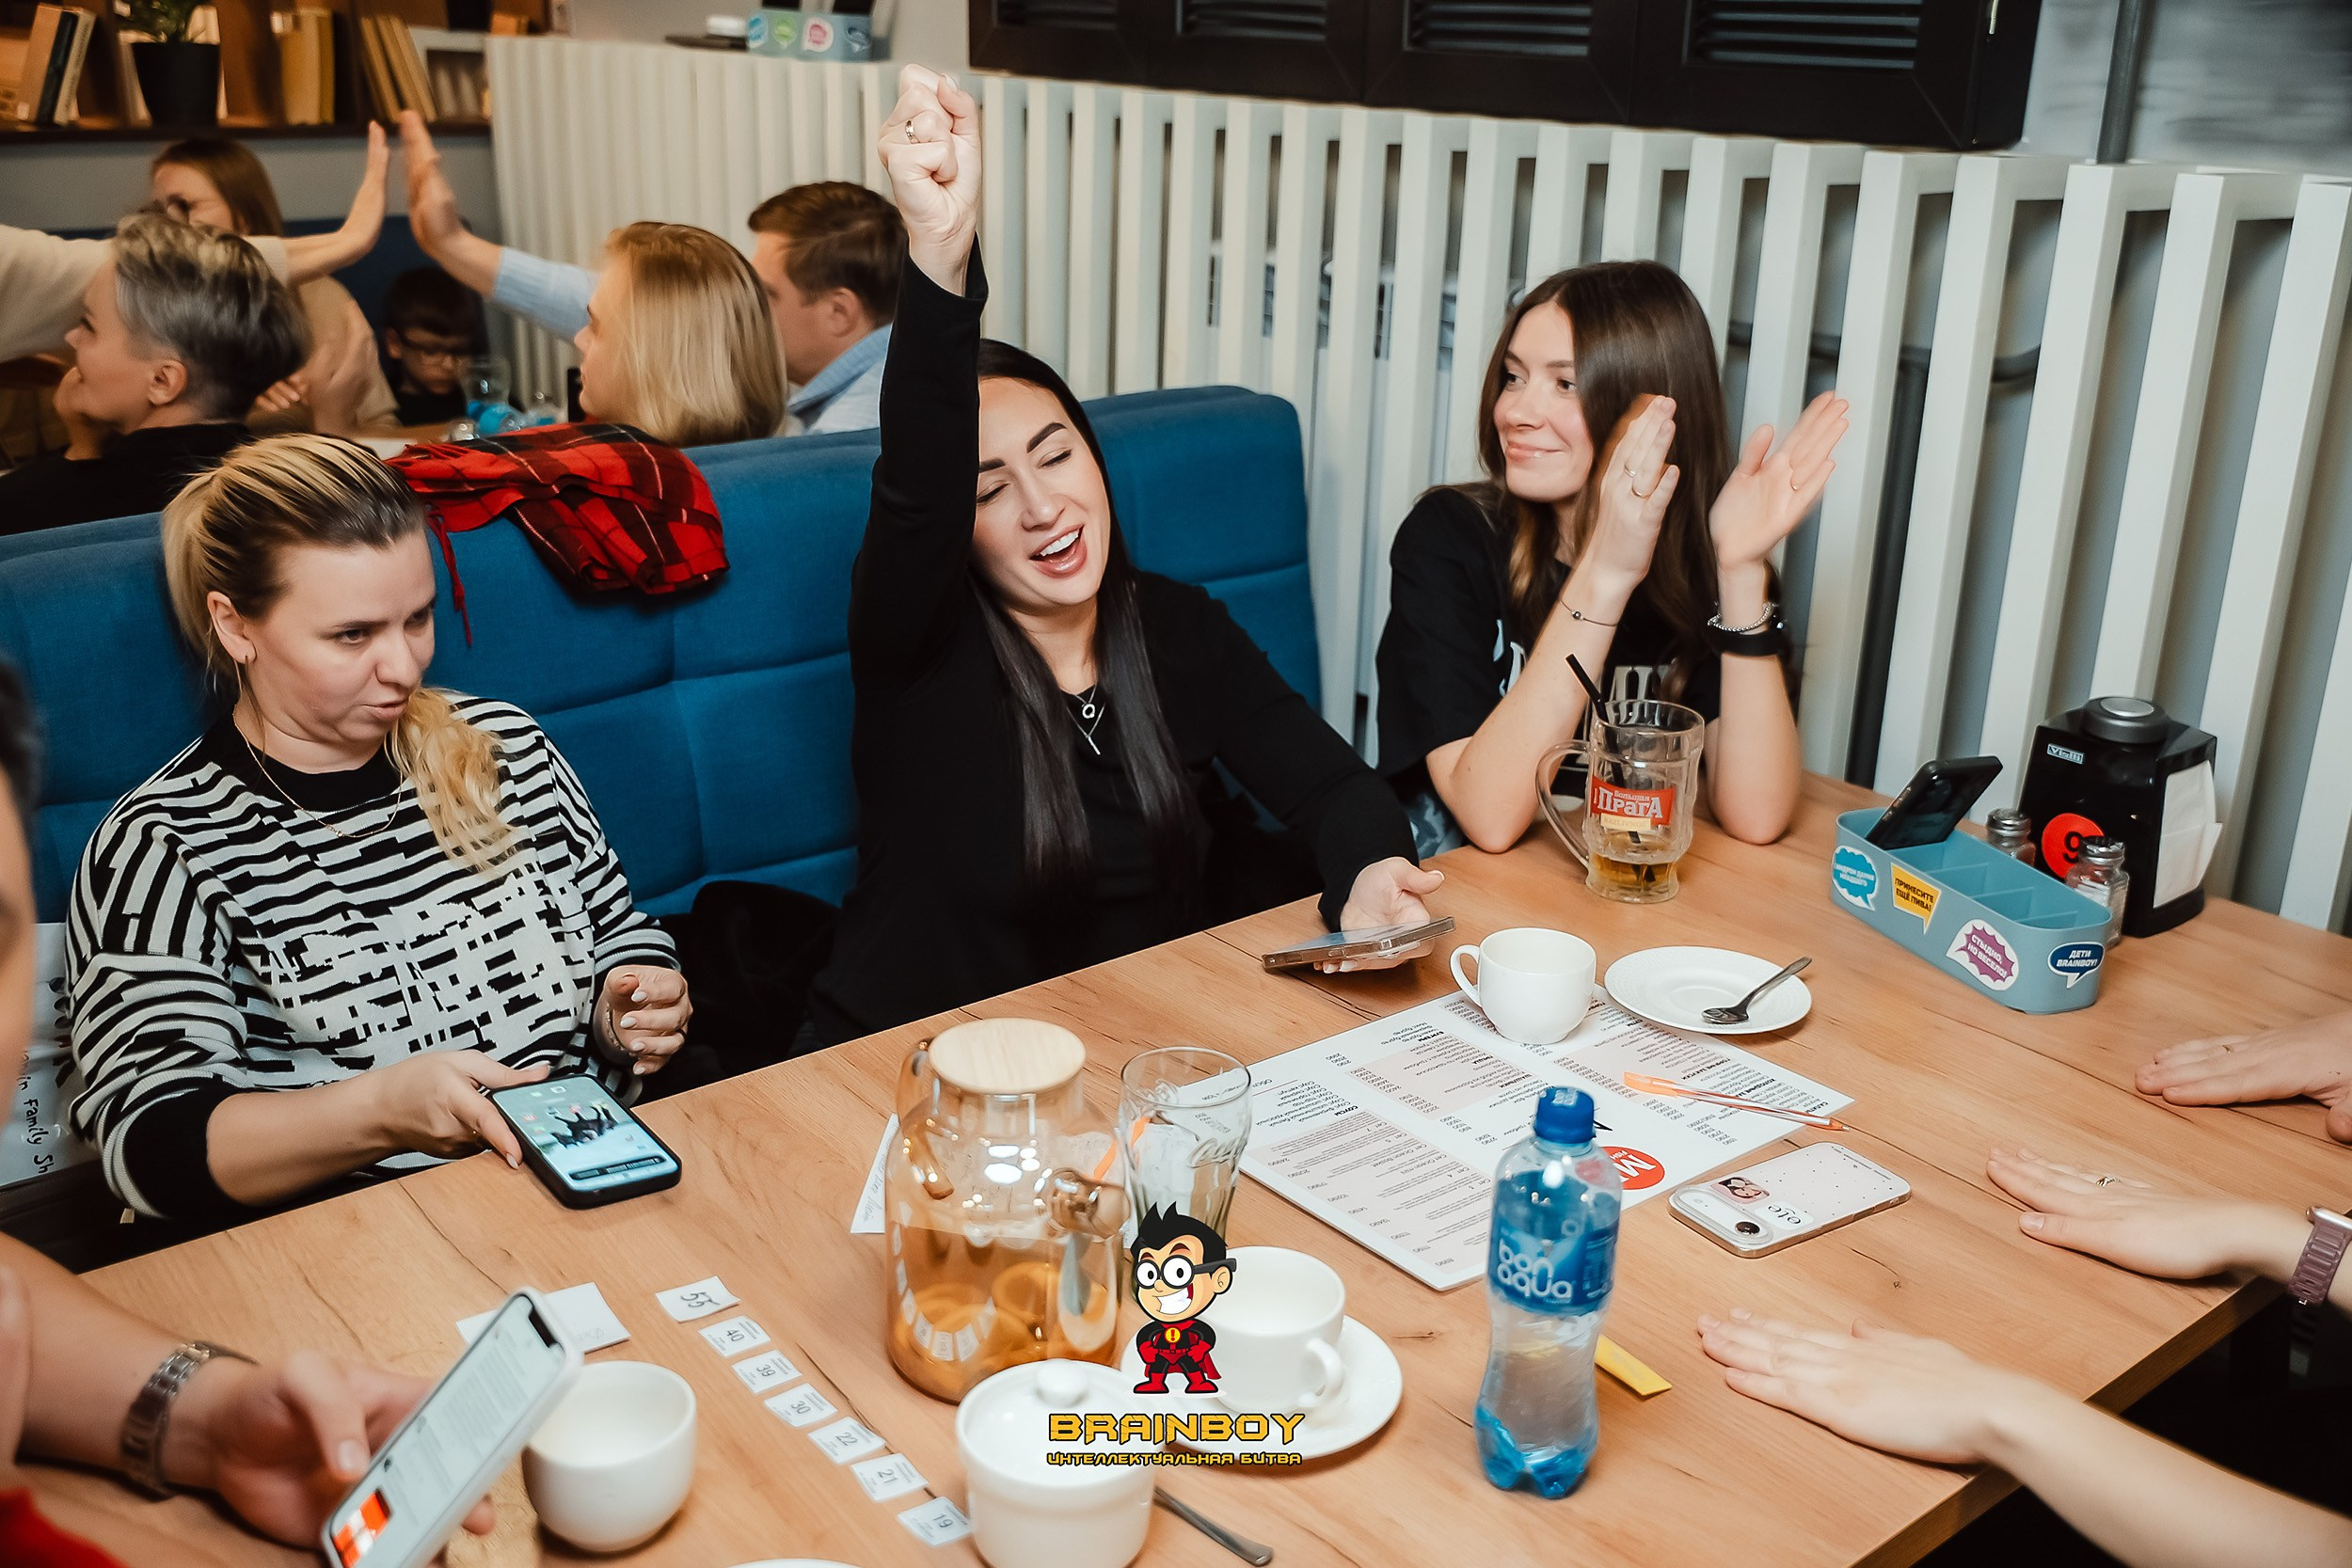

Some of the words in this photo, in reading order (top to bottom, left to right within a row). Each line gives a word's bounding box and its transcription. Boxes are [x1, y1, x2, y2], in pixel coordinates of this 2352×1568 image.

[2062, 831, 2085, 863] 9
[1895, 878, 1934, 904] ПРИНЕСИТЕ
[1896, 888, 1911, 901] ЕЩЁ
[1911, 895, 1931, 912] ПИВА!
[1971, 934, 2003, 964] СТЫДНО,
[2069, 950, 2091, 959] ДЕТИ
[1967, 942, 1977, 955] НО
[1977, 952, 2007, 979] ВЕСЕЛО!
[2056, 958, 2098, 967] BRAINBOY!
[1334, 1105, 1358, 1116] СОУСЫ
[24, 1099, 49, 1145] Family
[1606, 1149, 1630, 1160] FISH
[1498, 1238, 1553, 1278] bon
[726, 1329, 745, 1343] 40
[755, 1363, 776, 1378] 39
[790, 1400, 811, 1415] 30
[835, 1432, 858, 1446] 22
[877, 1468, 898, 1484] 21
[933, 1513, 954, 1528] 19
